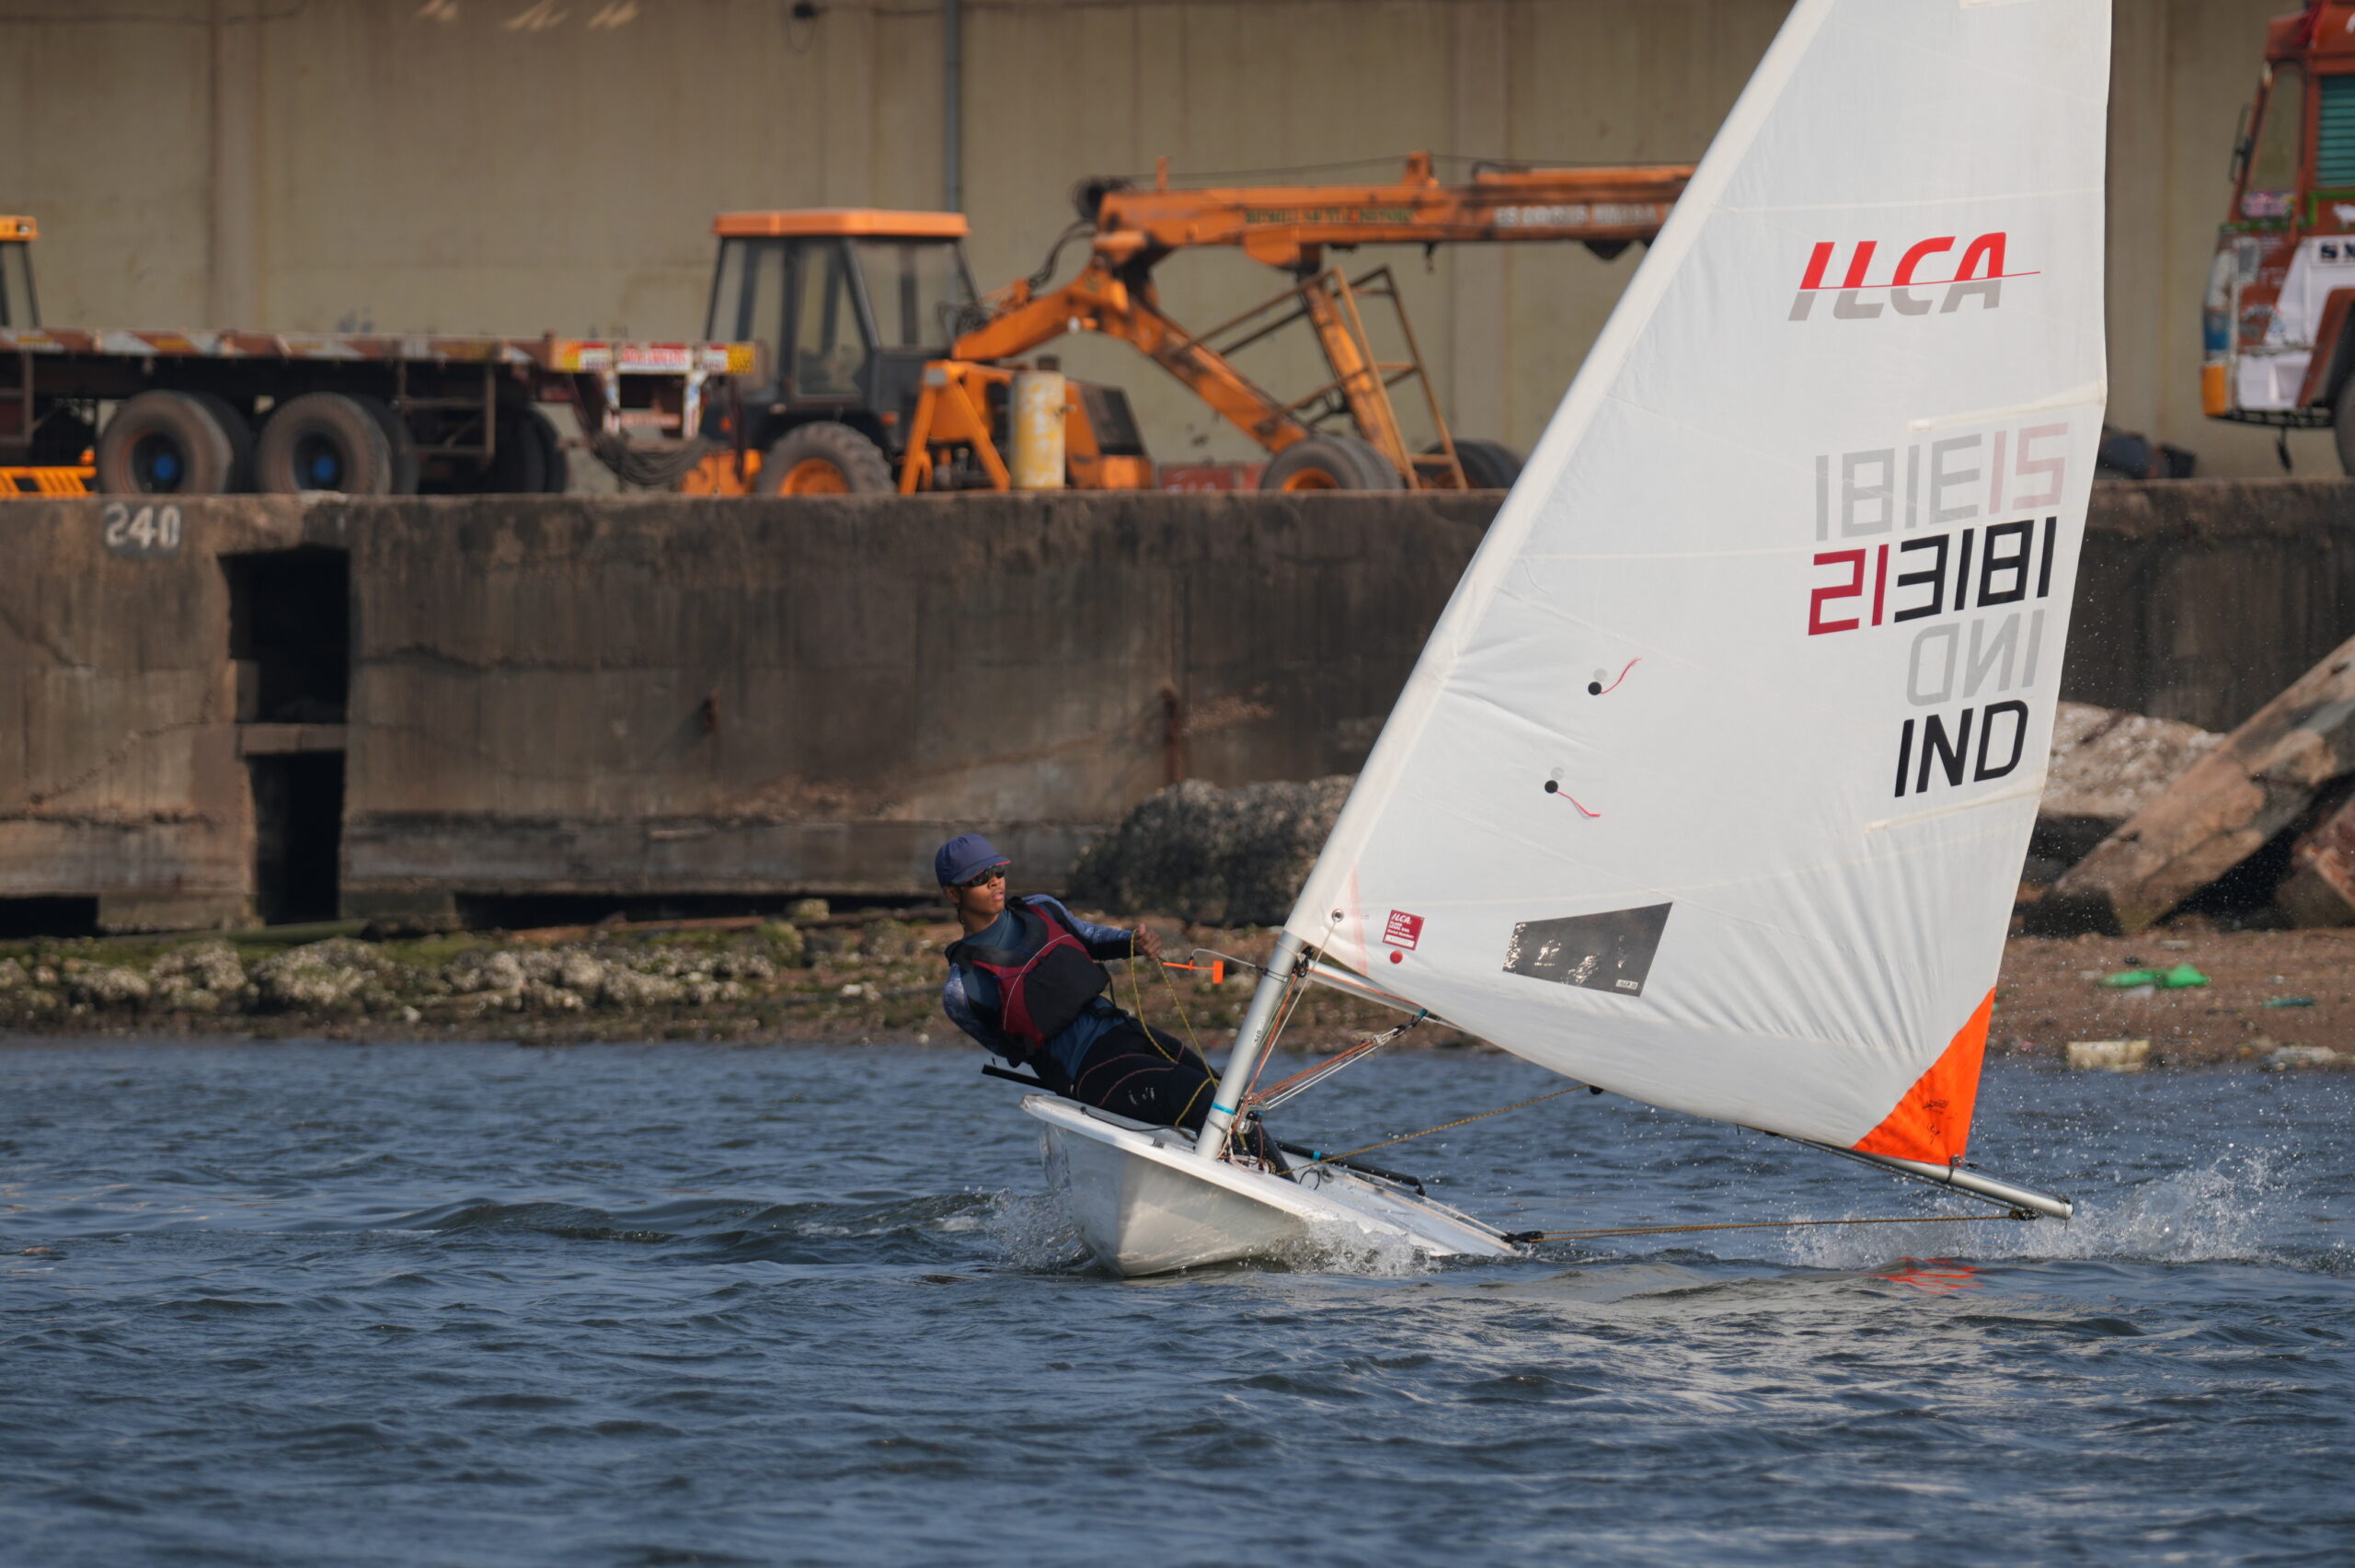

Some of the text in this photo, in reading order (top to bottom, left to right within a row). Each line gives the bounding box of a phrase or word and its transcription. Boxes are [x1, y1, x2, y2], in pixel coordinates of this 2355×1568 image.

[1787, 231, 2007, 322] ILCA
[104, 501, 181, 549] 240
[1808, 516, 2057, 635] 213181
[1894, 699, 2029, 798] IND
[1391, 912, 1411, 924] ILCA
